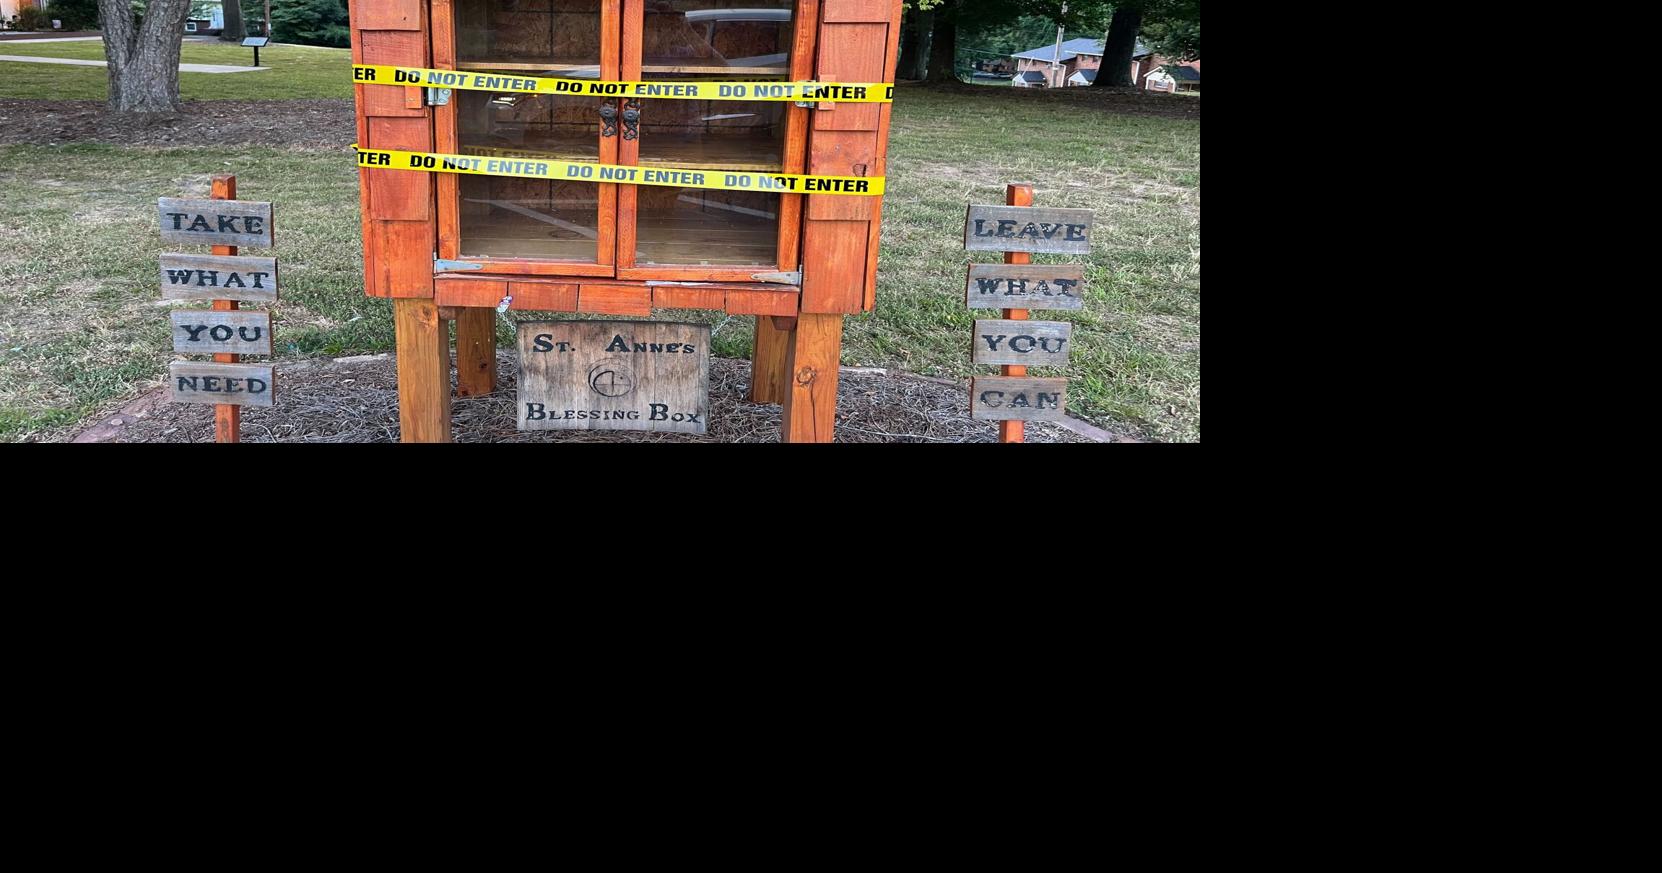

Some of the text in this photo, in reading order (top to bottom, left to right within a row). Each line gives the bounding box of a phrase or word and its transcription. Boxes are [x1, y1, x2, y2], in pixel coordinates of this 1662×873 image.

[353, 68, 376, 81] ER
[395, 69, 420, 83] DO
[427, 71, 468, 87] NOT
[474, 75, 536, 91] ENTER
[555, 81, 582, 93] DO
[589, 83, 629, 95] NOT
[634, 84, 698, 97] ENTER
[718, 84, 746, 97] DO
[754, 85, 795, 98] NOT
[802, 86, 866, 99] ENTER
[410, 155, 435, 168] DO
[442, 156, 480, 172] NOT
[487, 159, 548, 175] ENTER
[567, 165, 593, 178] DO
[600, 167, 638, 181] NOT
[644, 170, 704, 185] ENTER
[725, 174, 751, 188] DO
[758, 176, 798, 190] NOT
[805, 178, 868, 192] ENTER
[166, 213, 264, 235] TAKE
[974, 219, 1086, 242] LEAVE
[166, 269, 269, 289] WHAT
[975, 277, 1078, 297] WHAT
[180, 324, 262, 342] YOU
[982, 334, 1067, 354] YOU
[176, 376, 267, 394] NEED
[980, 390, 1061, 410] CAN
